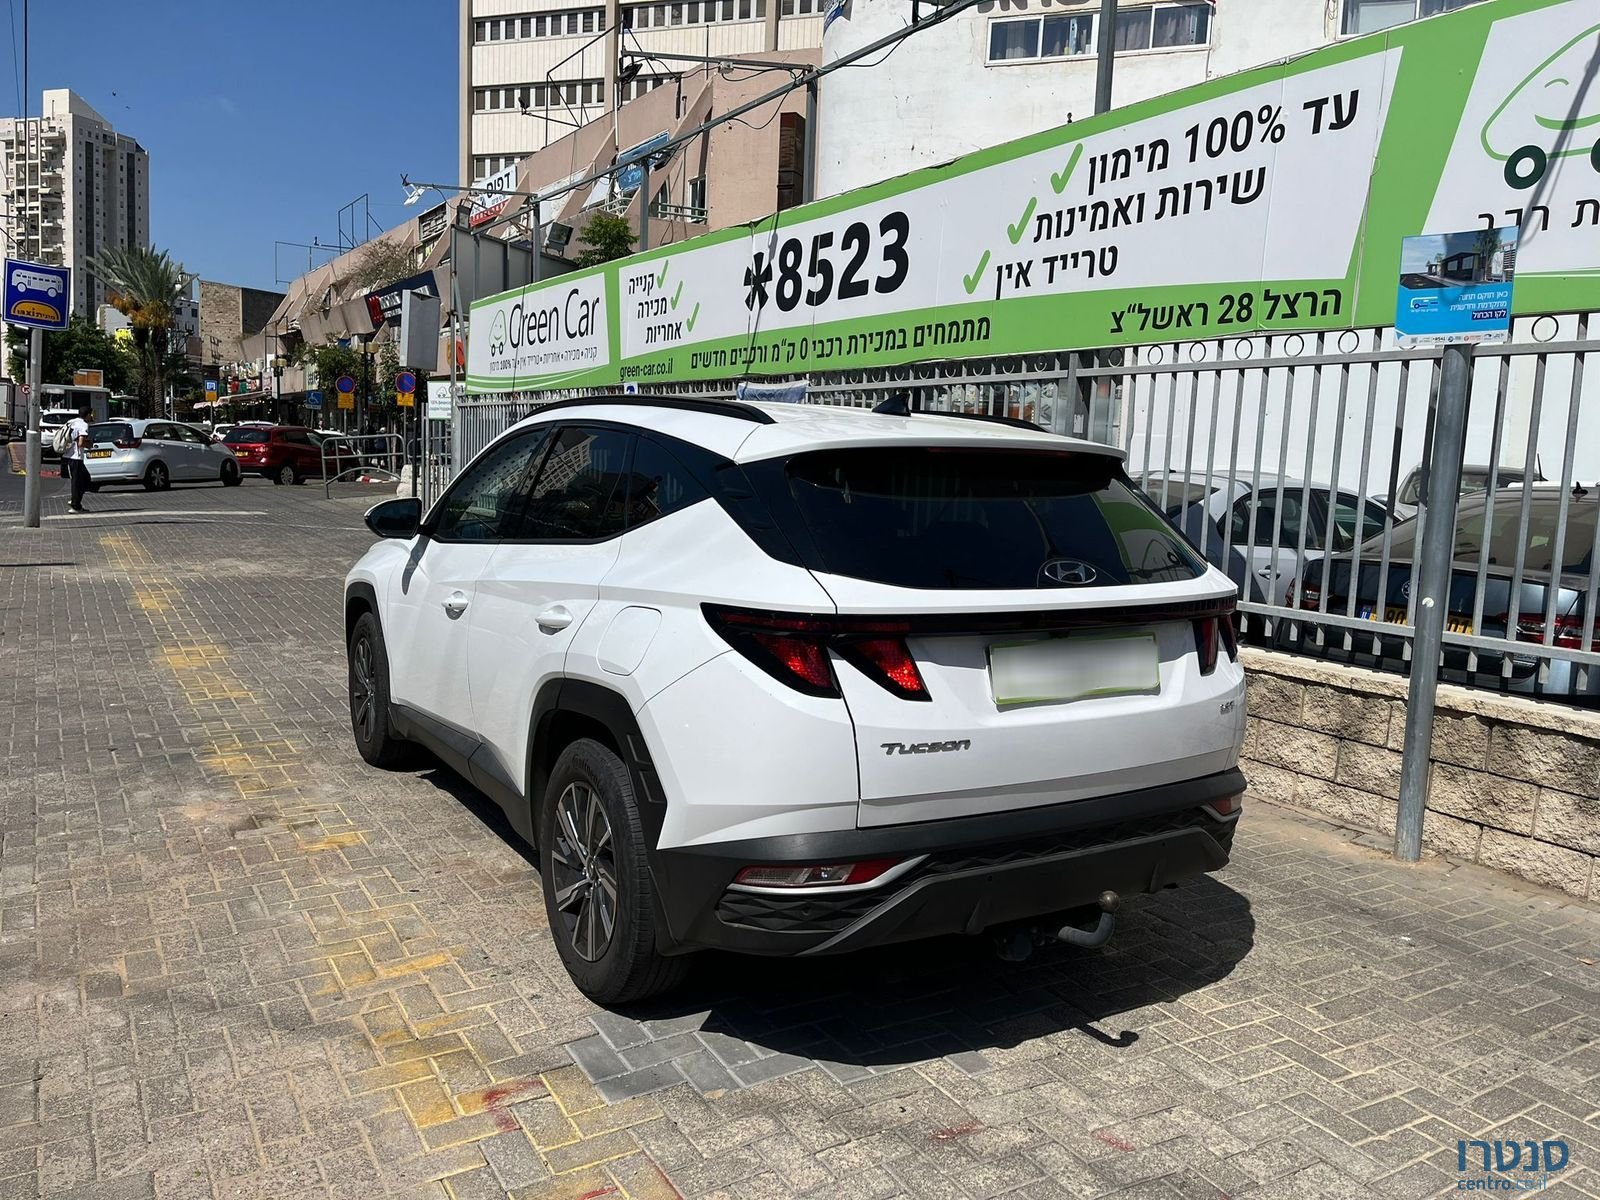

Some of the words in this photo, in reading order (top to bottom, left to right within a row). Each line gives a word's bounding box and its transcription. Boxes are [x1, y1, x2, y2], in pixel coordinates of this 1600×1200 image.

[1302, 89, 1359, 135] עד
[1184, 104, 1286, 163] 100%
[1088, 137, 1170, 197] מימון
[1154, 166, 1267, 221] שירות
[1033, 192, 1146, 244] ואמינות
[995, 258, 1034, 301] אין
[1042, 245, 1119, 285] טרייד
[628, 272, 655, 296] קנייה
[509, 303, 560, 349] Green
[564, 288, 600, 340] Car
[637, 296, 668, 319] מכירה
[1109, 302, 1209, 334] ראשל"צ
[1217, 292, 1254, 325] 28
[1263, 288, 1343, 321] הרצל
[645, 321, 683, 345] אחריות
[811, 336, 843, 359] רכבי
[846, 328, 908, 358] במכירת
[912, 316, 991, 348] מתמחים
[619, 358, 674, 381] green-car.co.il
[690, 349, 727, 370] חדשים
[729, 348, 768, 366] ורכבים
